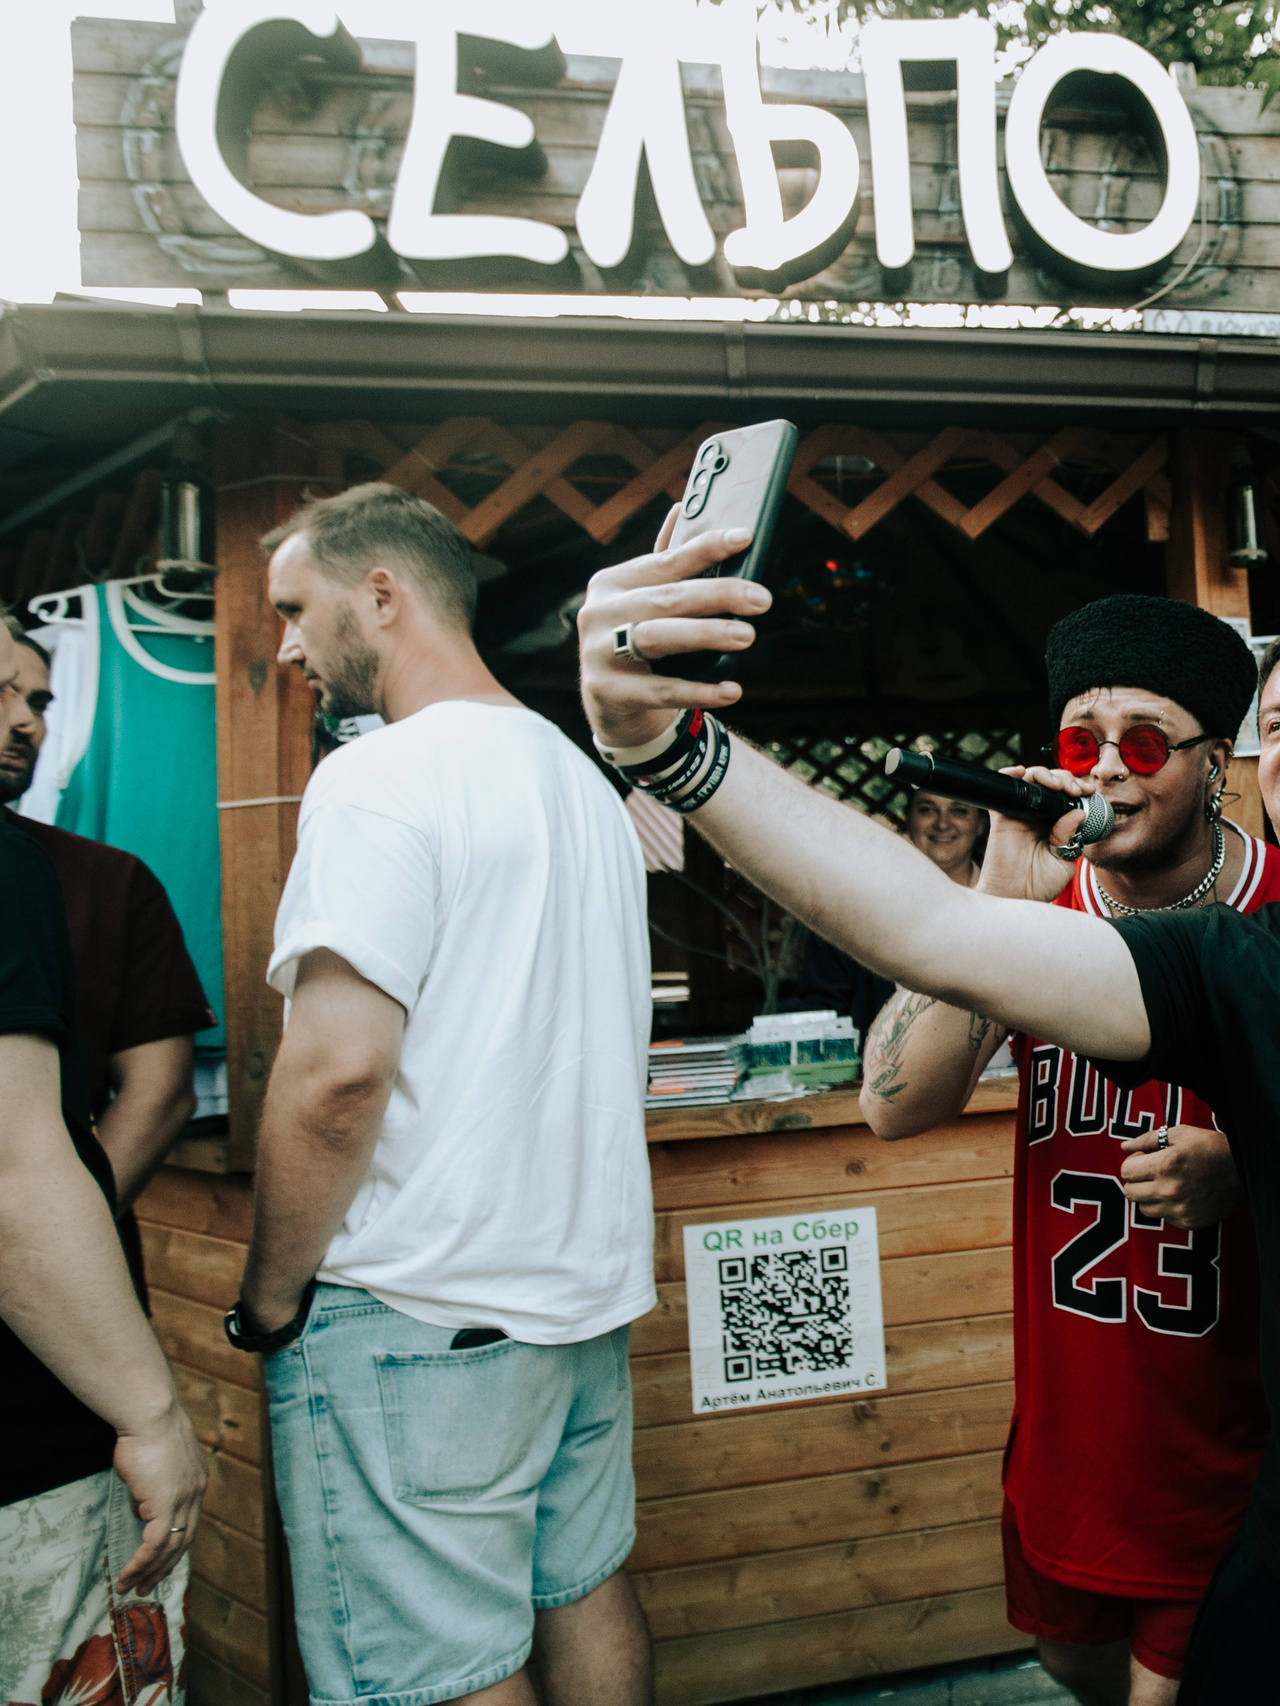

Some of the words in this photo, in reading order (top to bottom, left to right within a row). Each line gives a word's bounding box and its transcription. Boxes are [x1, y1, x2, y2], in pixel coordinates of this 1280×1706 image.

[175, 0, 1200, 273] СЕЛЬПО
[703, 1229, 743, 1251] QR
[753, 1230, 783, 1246] на
[793, 1220, 859, 1241] Сбер
[1051, 1169, 1221, 1337] 23
[701, 1393, 750, 1409] Артём
[756, 1379, 860, 1400] Анатольевич
